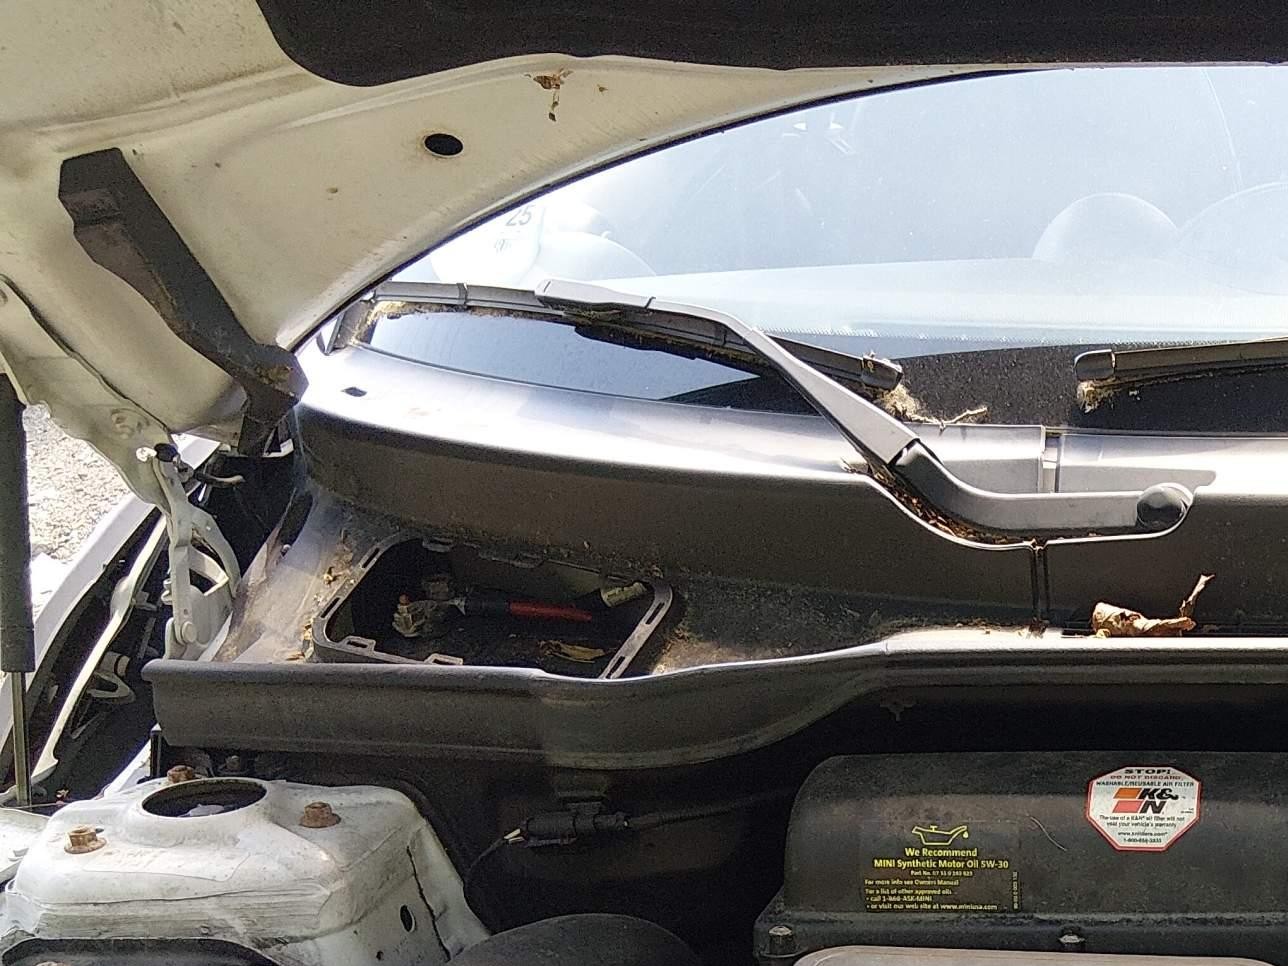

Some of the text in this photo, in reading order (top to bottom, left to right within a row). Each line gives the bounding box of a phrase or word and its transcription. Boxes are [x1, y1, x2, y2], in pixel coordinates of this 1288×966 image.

[905, 848, 977, 857] We Recommend
[874, 859, 1009, 869] MINI Synthetic Motor Oil 5W-30
